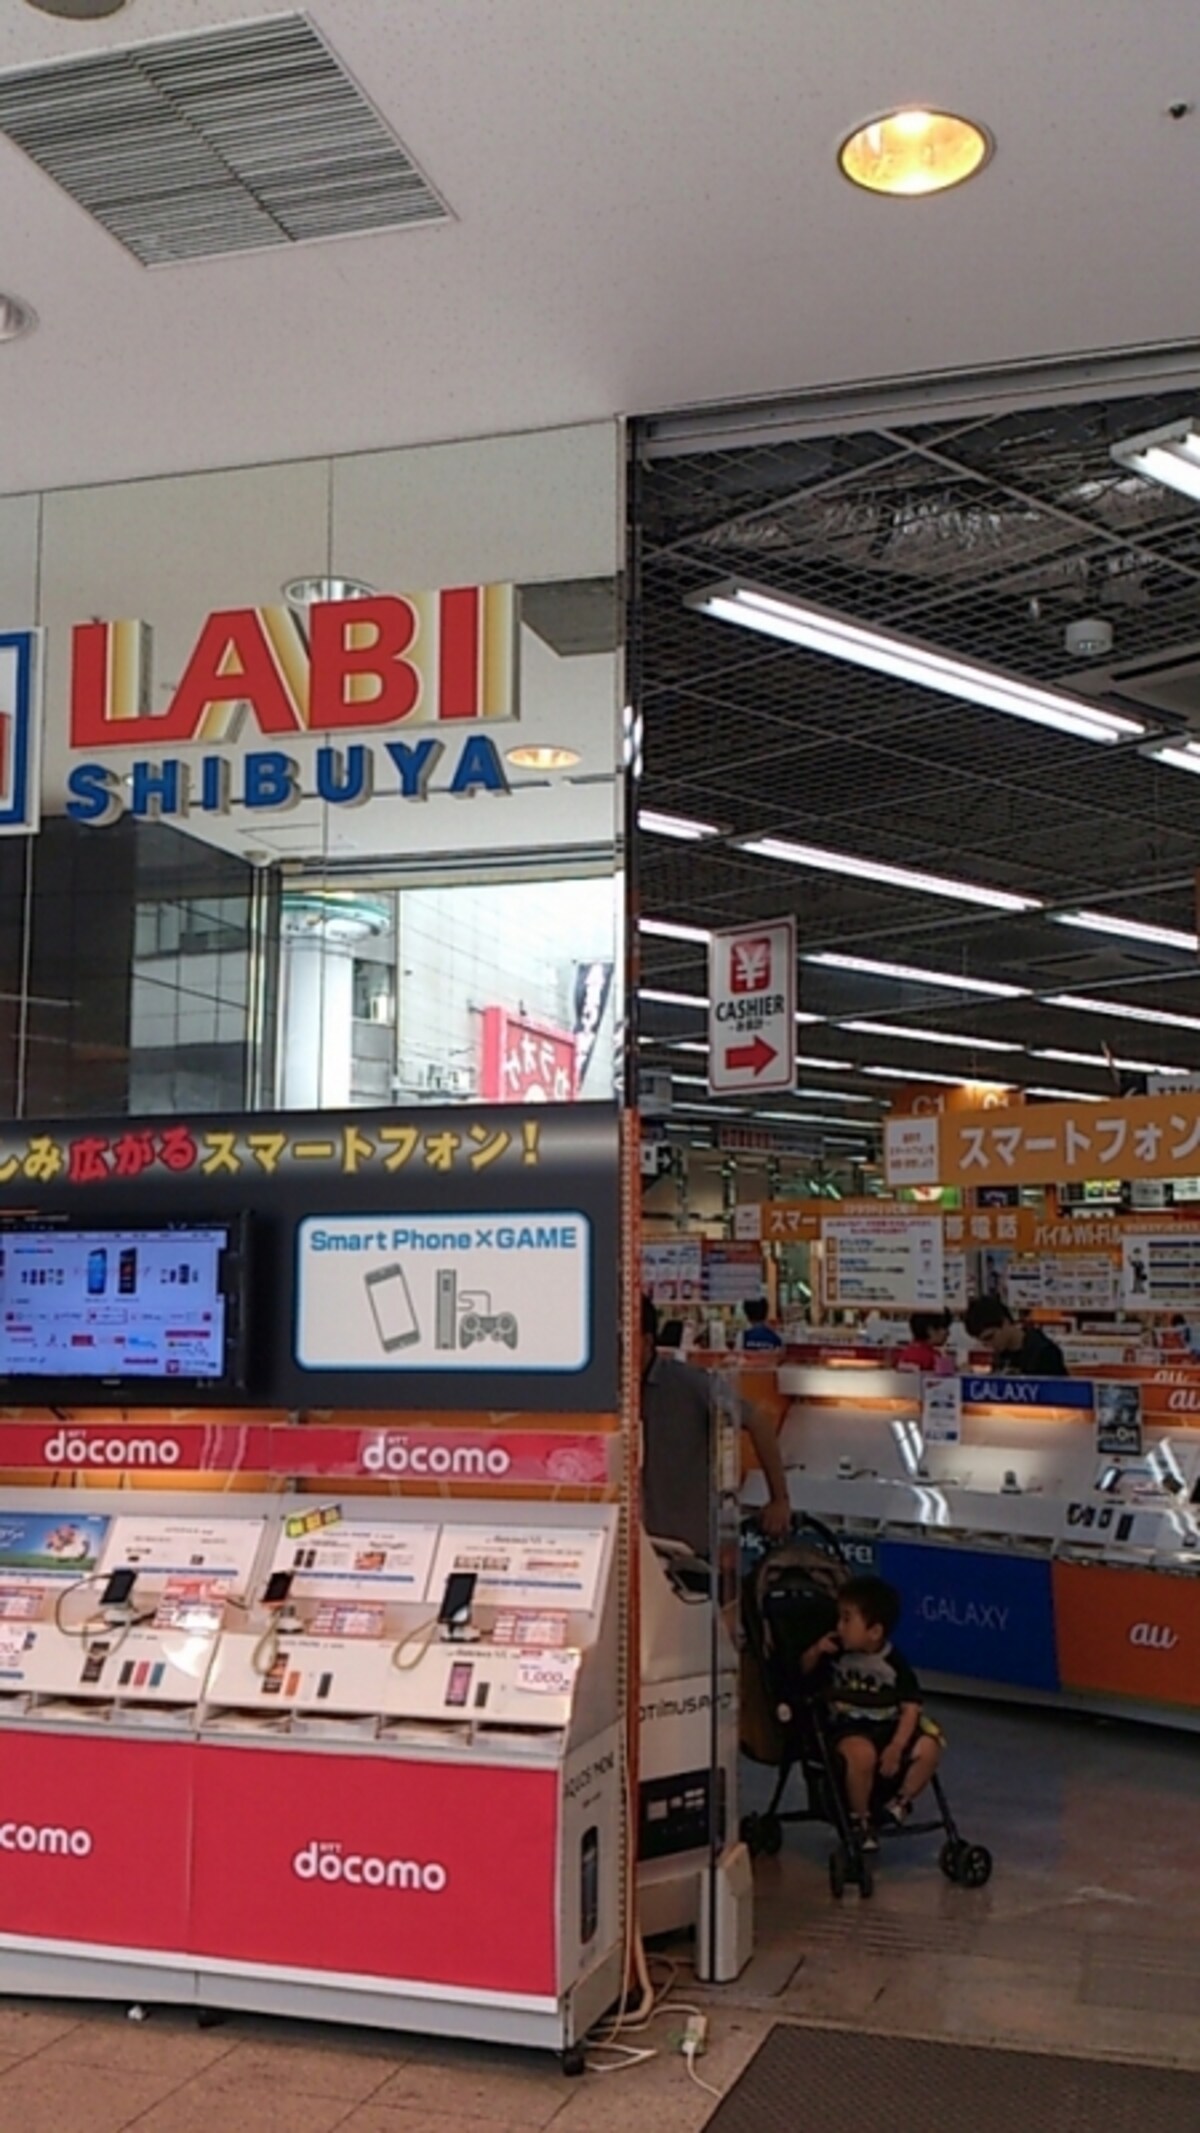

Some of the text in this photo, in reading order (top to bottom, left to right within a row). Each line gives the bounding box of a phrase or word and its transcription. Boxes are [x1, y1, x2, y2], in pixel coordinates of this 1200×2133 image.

[70, 584, 498, 749] LABI
[66, 734, 508, 823] SHIBUYA
[716, 994, 784, 1022] CASHIER
[310, 1230, 387, 1251] Smart
[970, 1380, 1040, 1401] GALAXY
[44, 1429, 180, 1465] docomo
[362, 1434, 510, 1474] docomo
[922, 1595, 1010, 1632] GALAXY
[1129, 1622, 1178, 1649] au
[293, 1842, 447, 1892] docomo
